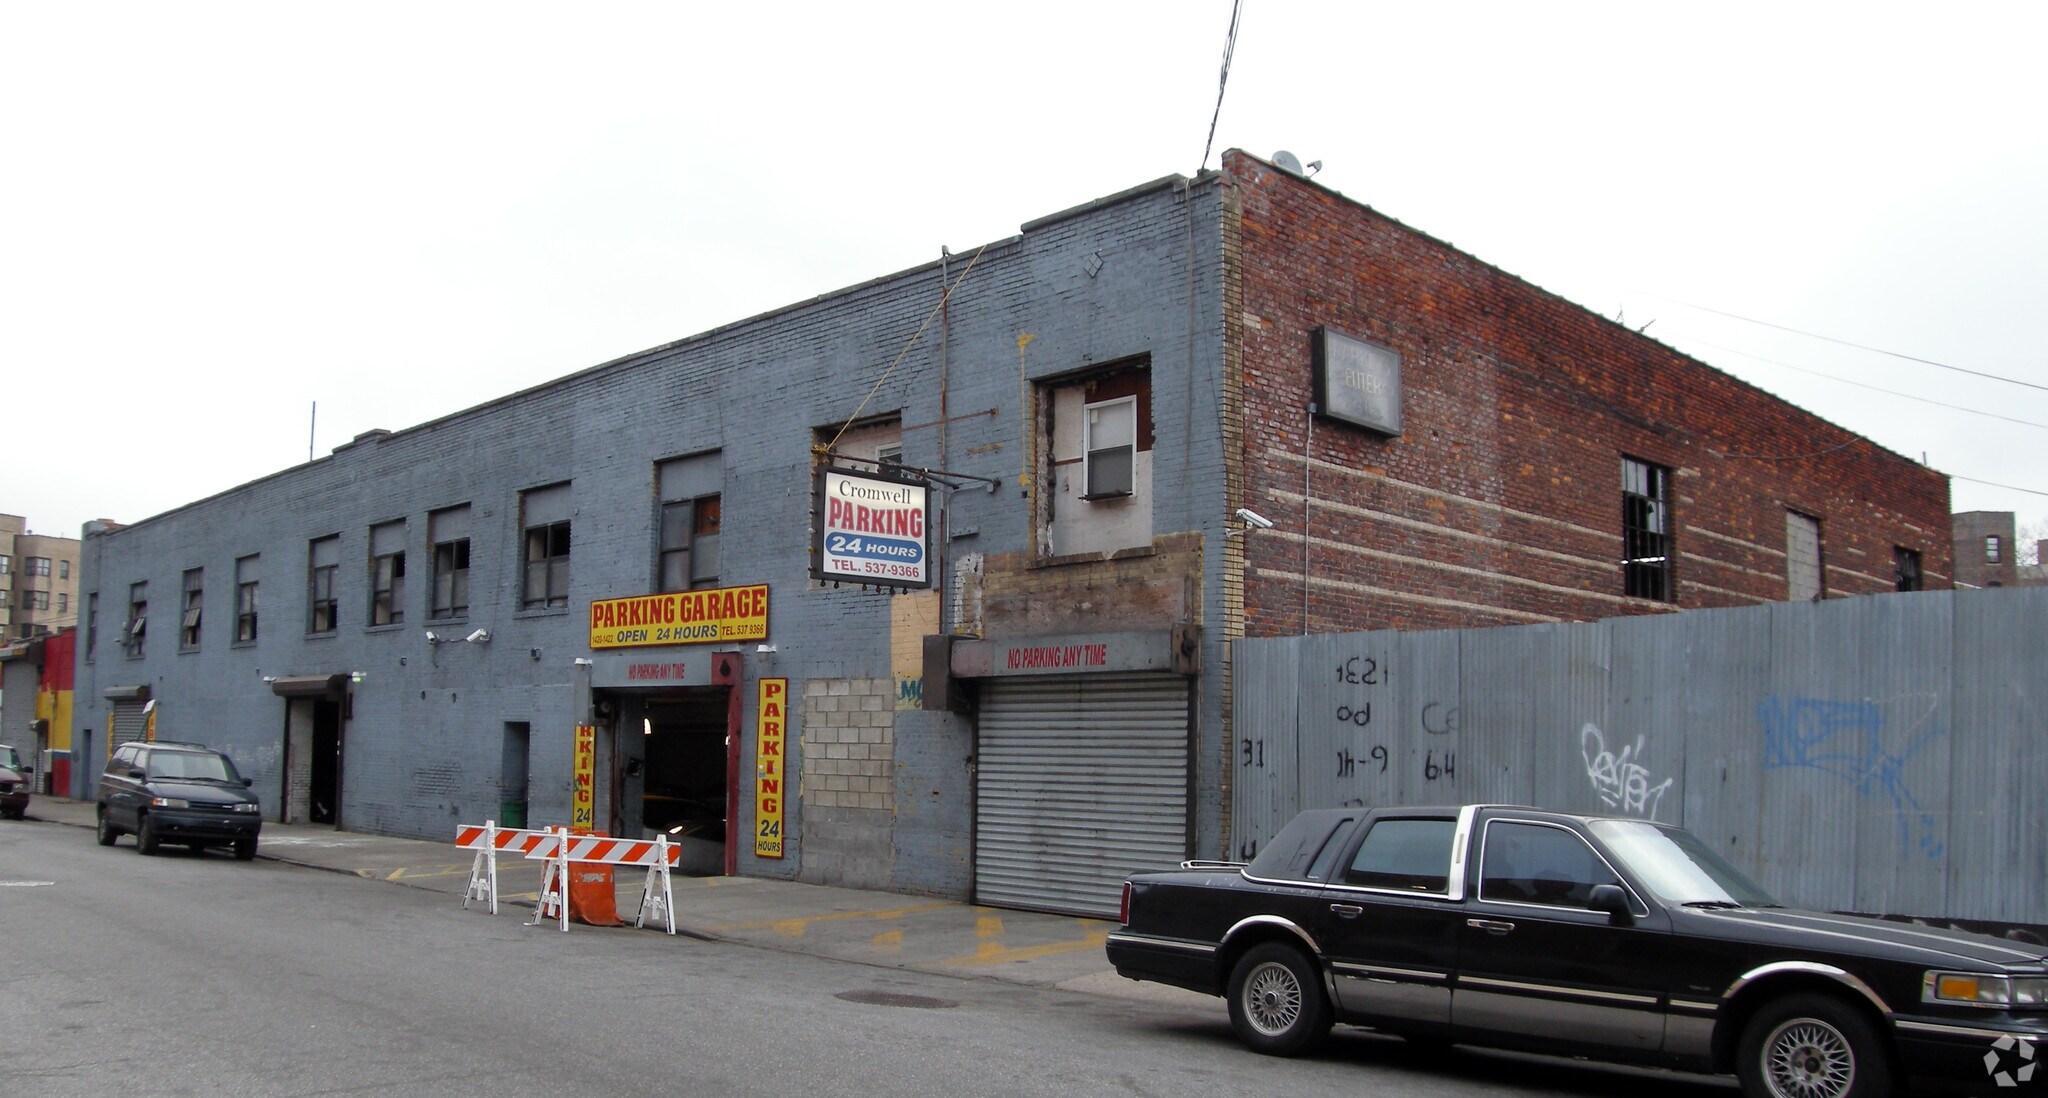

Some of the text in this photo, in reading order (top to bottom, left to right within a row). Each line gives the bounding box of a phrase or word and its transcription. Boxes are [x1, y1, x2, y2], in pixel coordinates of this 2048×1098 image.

[839, 480, 911, 504] Cromwell
[828, 496, 923, 538] PARKING
[830, 536, 917, 558] 24 HOURS
[832, 559, 919, 578] TEL. 537-9366
[592, 589, 766, 629] PARKING GARAGE
[592, 624, 764, 644] 1420-1422 OPEN 24 HOURS TEL. 537 9366
[1007, 644, 1107, 669] NO PARKING ANY TIME
[761, 683, 781, 813] PARKING
[576, 807, 591, 823] 24
[760, 819, 780, 838] 24
[758, 840, 781, 853] HOURS
